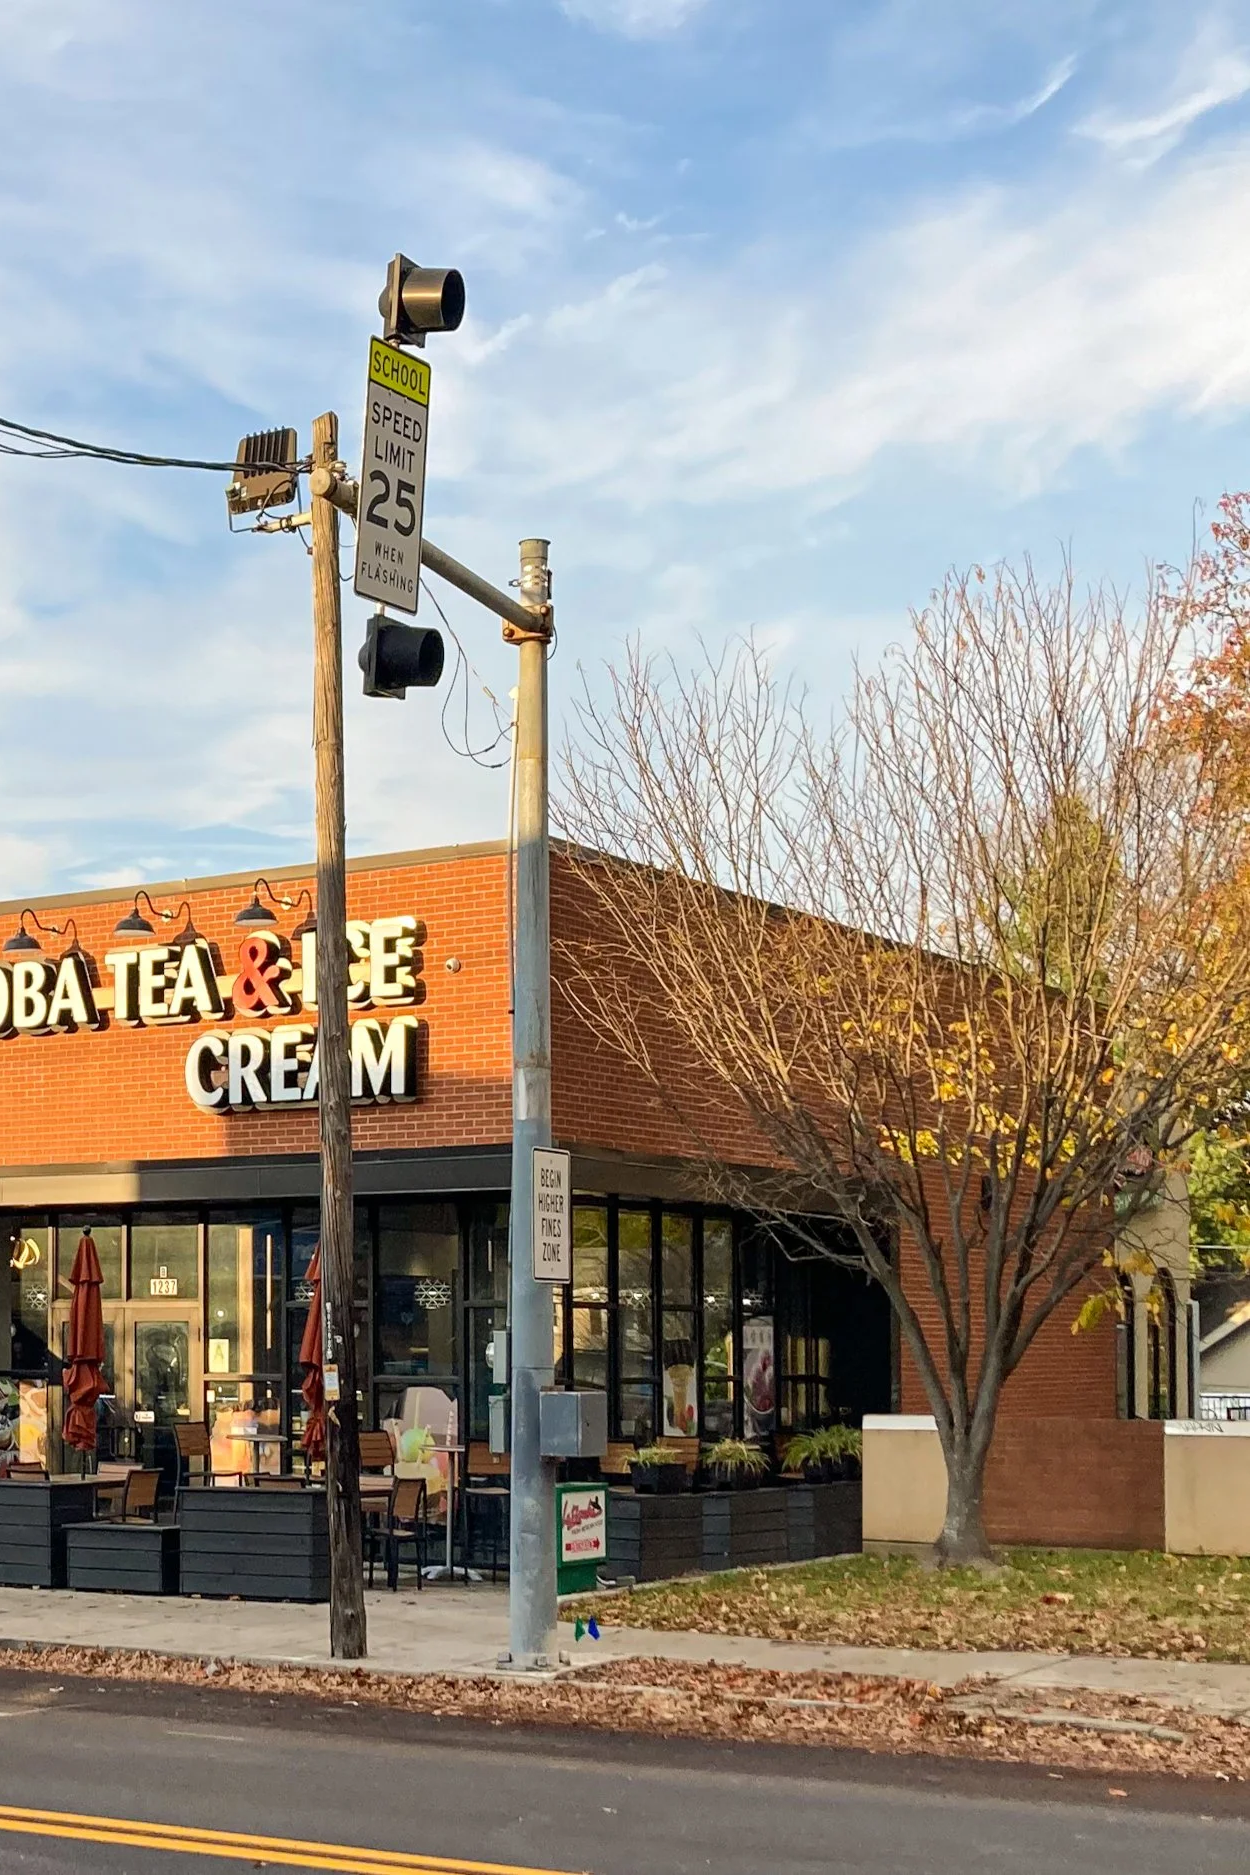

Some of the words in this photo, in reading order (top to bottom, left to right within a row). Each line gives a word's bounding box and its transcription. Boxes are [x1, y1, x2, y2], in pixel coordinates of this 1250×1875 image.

[372, 350, 426, 397] SCHOOL
[371, 401, 422, 443] SPEED
[374, 435, 415, 473] LIMIT
[366, 470, 416, 537] 25
[374, 540, 404, 565] WHEN
[360, 561, 413, 594] FLASHING
[105, 940, 224, 1020] TEA
[232, 930, 279, 1011] &
[540, 1168, 562, 1189] BEGIN
[538, 1193, 564, 1214] HIGHER
[541, 1218, 562, 1238] FINES
[542, 1243, 561, 1262] ZONE
[152, 1280, 176, 1294] 1237
